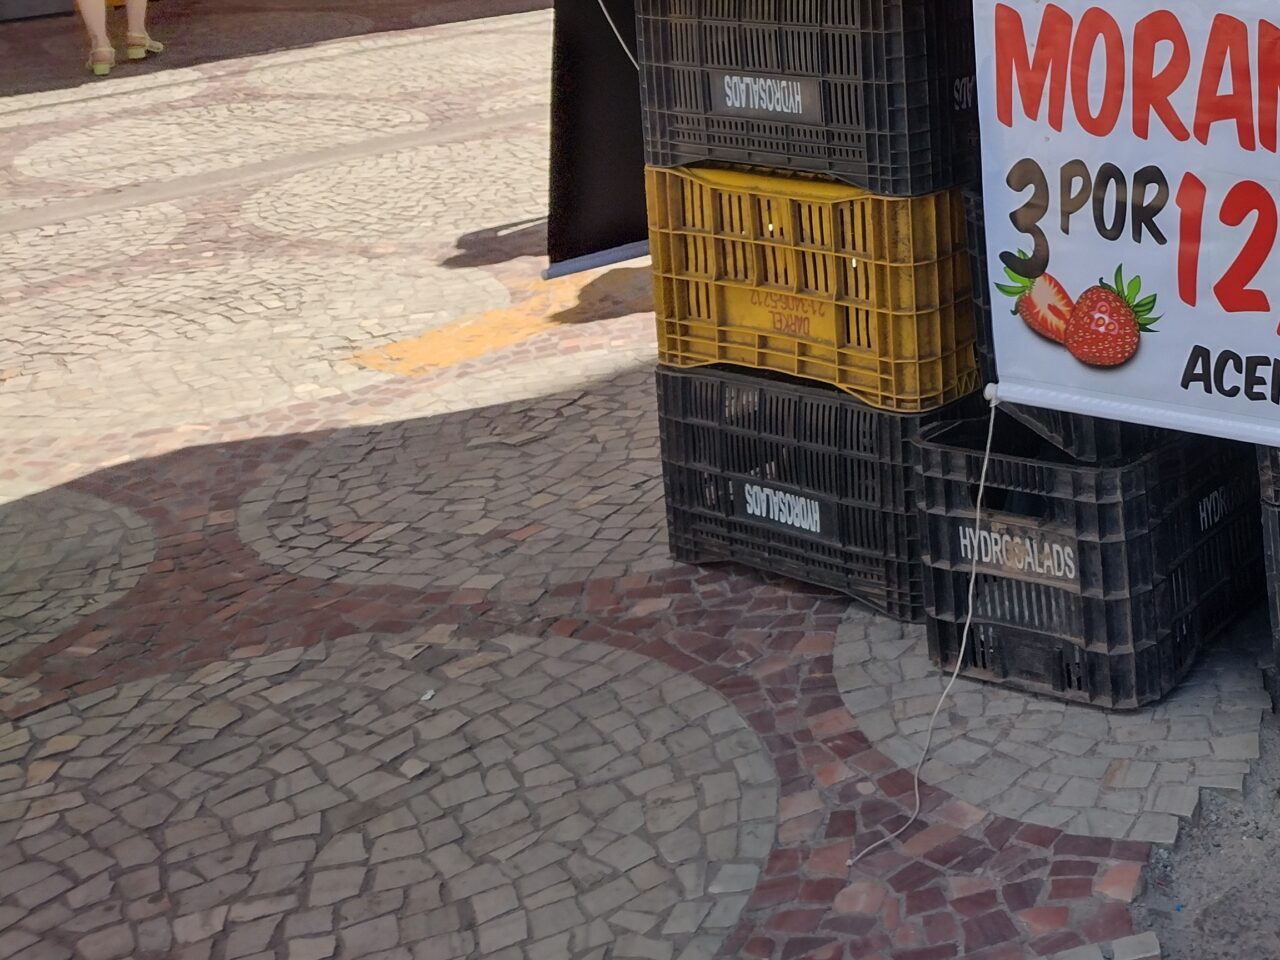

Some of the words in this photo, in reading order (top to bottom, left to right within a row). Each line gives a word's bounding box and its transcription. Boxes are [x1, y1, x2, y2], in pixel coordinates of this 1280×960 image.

[724, 74, 802, 114] HYDROSALADS
[999, 157, 1050, 279] 3
[1060, 158, 1170, 246] POR
[744, 483, 820, 533] HYDROSALADS
[959, 525, 1076, 579] HYDROSALADS
